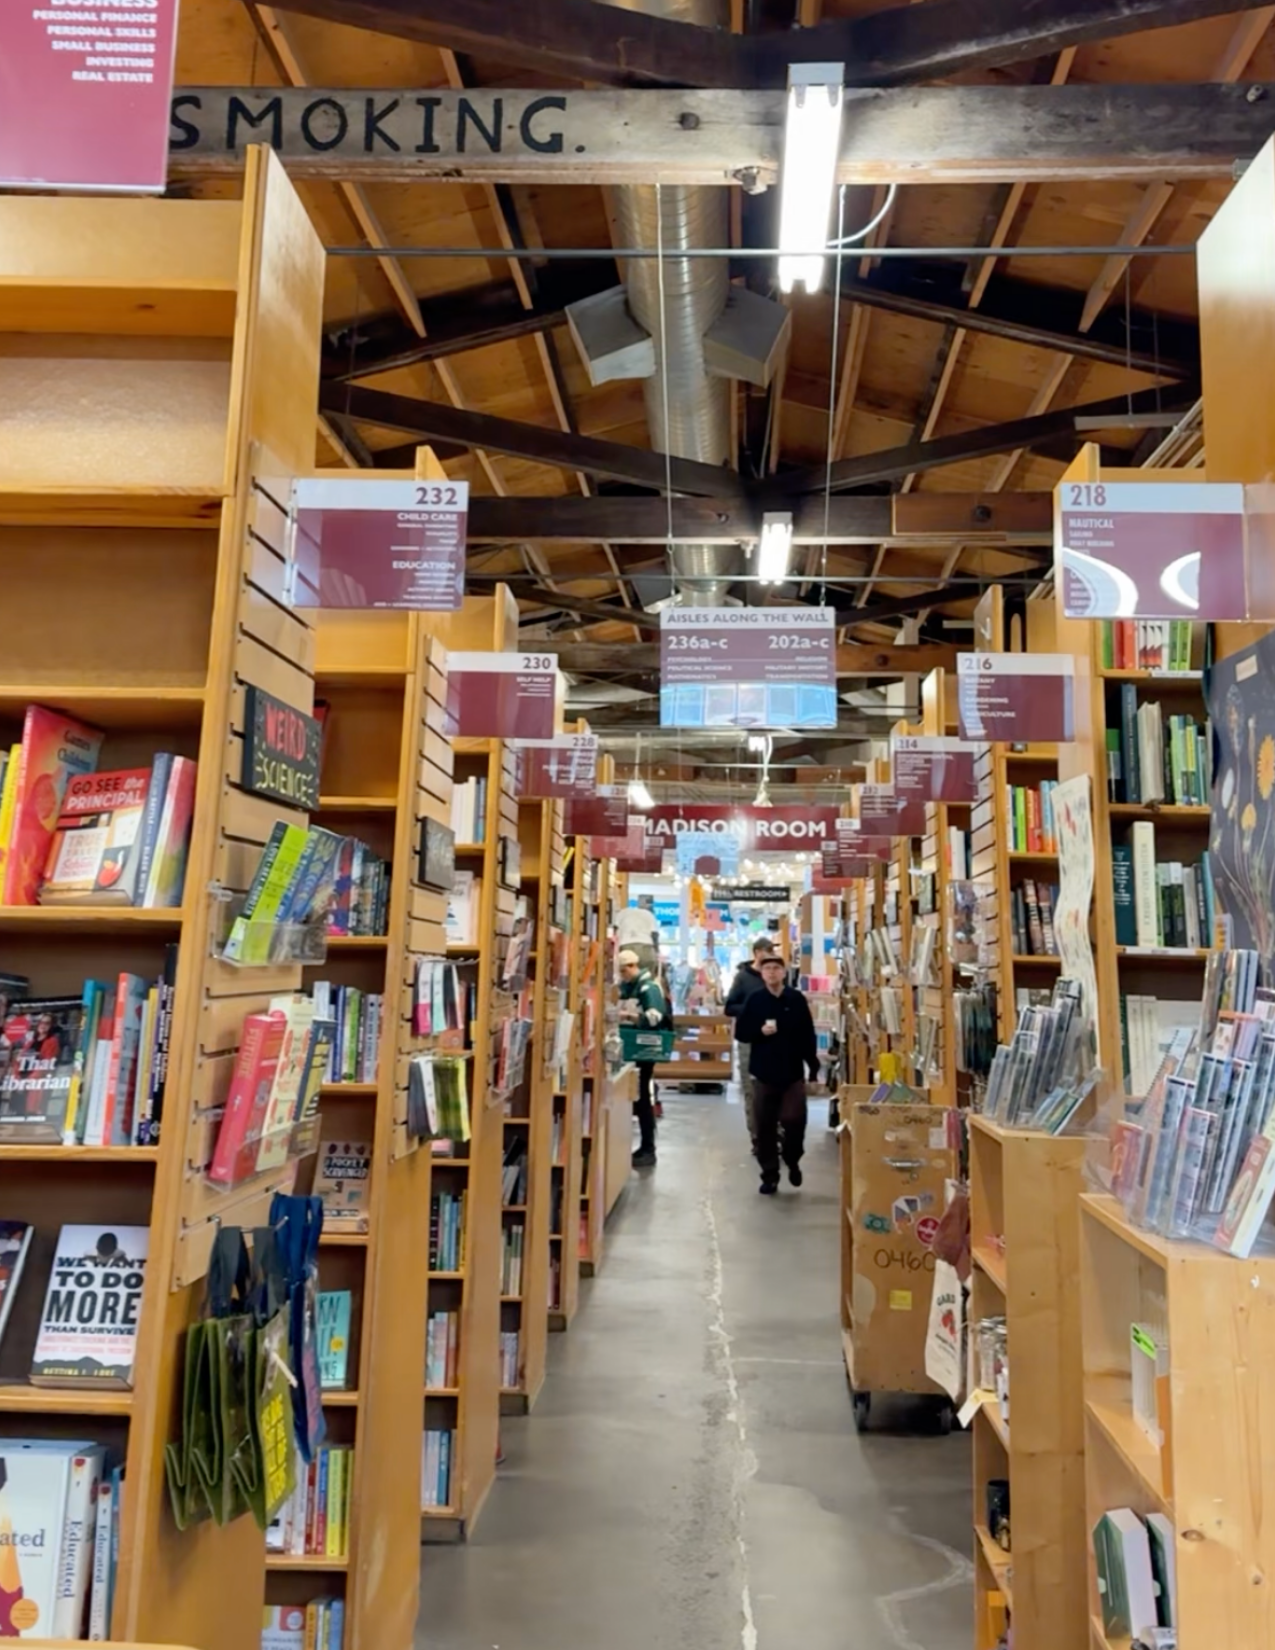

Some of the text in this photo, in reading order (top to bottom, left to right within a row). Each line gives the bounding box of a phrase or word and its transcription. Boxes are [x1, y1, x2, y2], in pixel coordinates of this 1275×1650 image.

[33, 9, 157, 23] PERSONAL FINANCE
[47, 25, 156, 38] PERSONAL SKILLS
[51, 40, 155, 53] SMALL BUSINESS
[85, 56, 154, 68] INVESTING
[72, 70, 153, 83] REAL ESTATE
[416, 487, 458, 505] 232
[1070, 484, 1106, 506] 218
[397, 513, 429, 521] CHILD
[1069, 518, 1114, 528] NAUTICAL
[392, 561, 455, 569] EDUCATION
[667, 613, 828, 623] AISLES ALONG THE WALL
[667, 635, 728, 649] 236a-c
[768, 635, 829, 649] 202a-c
[523, 657, 551, 669] 230
[964, 658, 992, 670] 216
[266, 702, 307, 761] WEIRD
[572, 737, 595, 747] 228
[71, 776, 146, 795] GO SEE the
[256, 757, 308, 802] SCIENCE
[66, 790, 143, 811] PRINCIPAL
[755, 820, 826, 837] ROOM
[239, 1027, 261, 1079] FUTURE
[19, 1056, 57, 1071] That
[55, 1257, 147, 1269] WE WANT
[874, 1249, 937, 1272] 0460
[55, 1271, 144, 1289] TO DO
[45, 1290, 142, 1325] MORE
[44, 1325, 136, 1336] THAN SURVIVE
[63, 1521, 83, 1599] Educated
[95, 1525, 108, 1584] Educated
